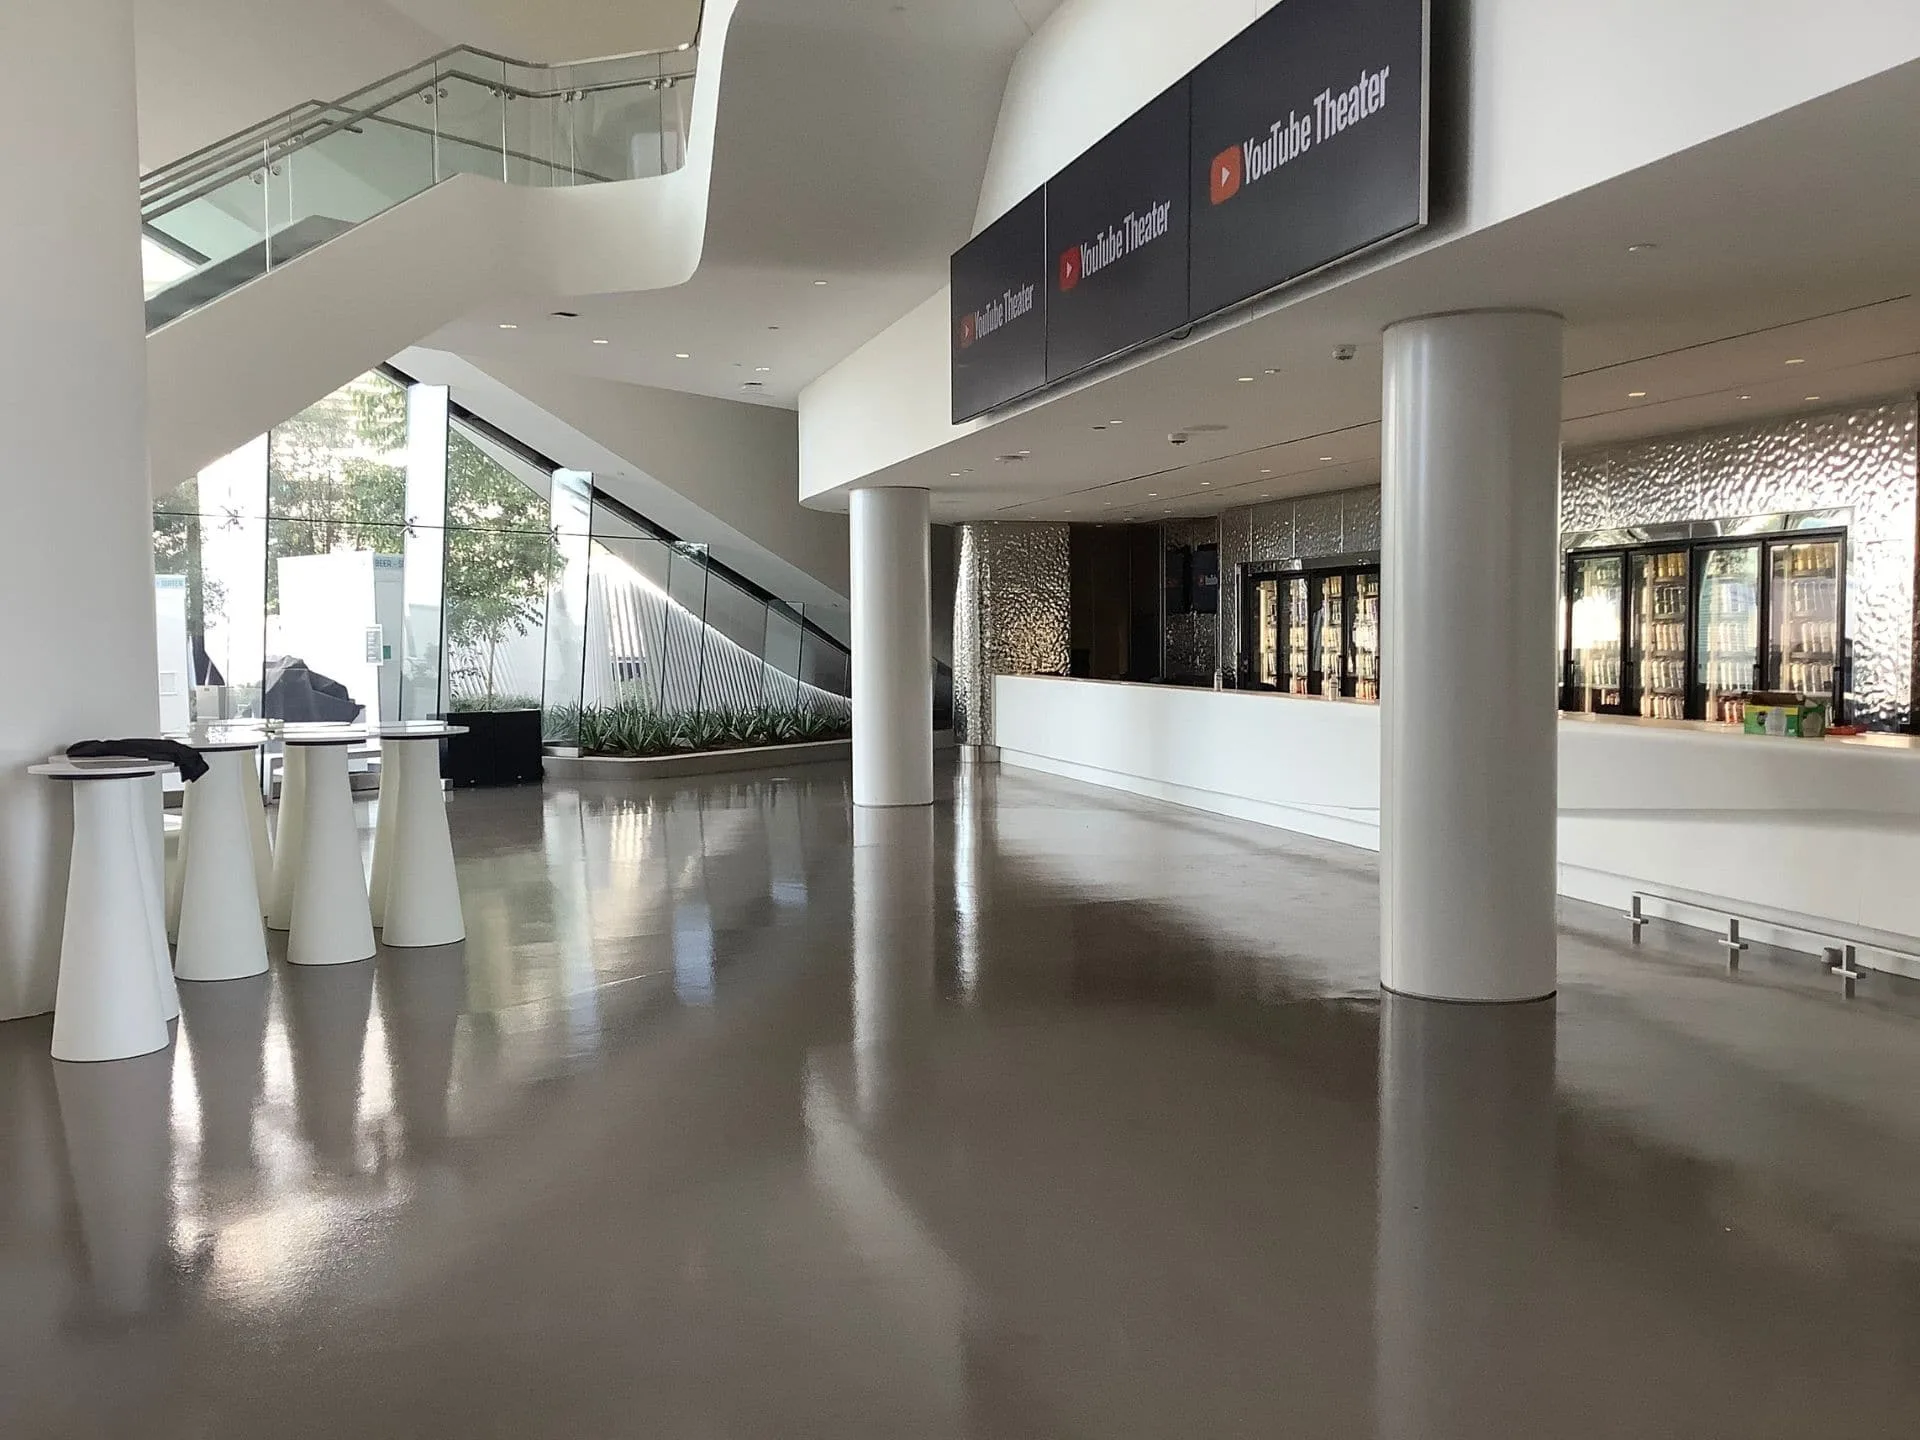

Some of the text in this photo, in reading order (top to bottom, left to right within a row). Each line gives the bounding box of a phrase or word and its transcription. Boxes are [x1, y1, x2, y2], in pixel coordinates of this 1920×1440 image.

[1243, 64, 1390, 185] YouTube Theater
[1080, 200, 1170, 279] YouTube Theater
[974, 282, 1034, 340] YouTube Theater
